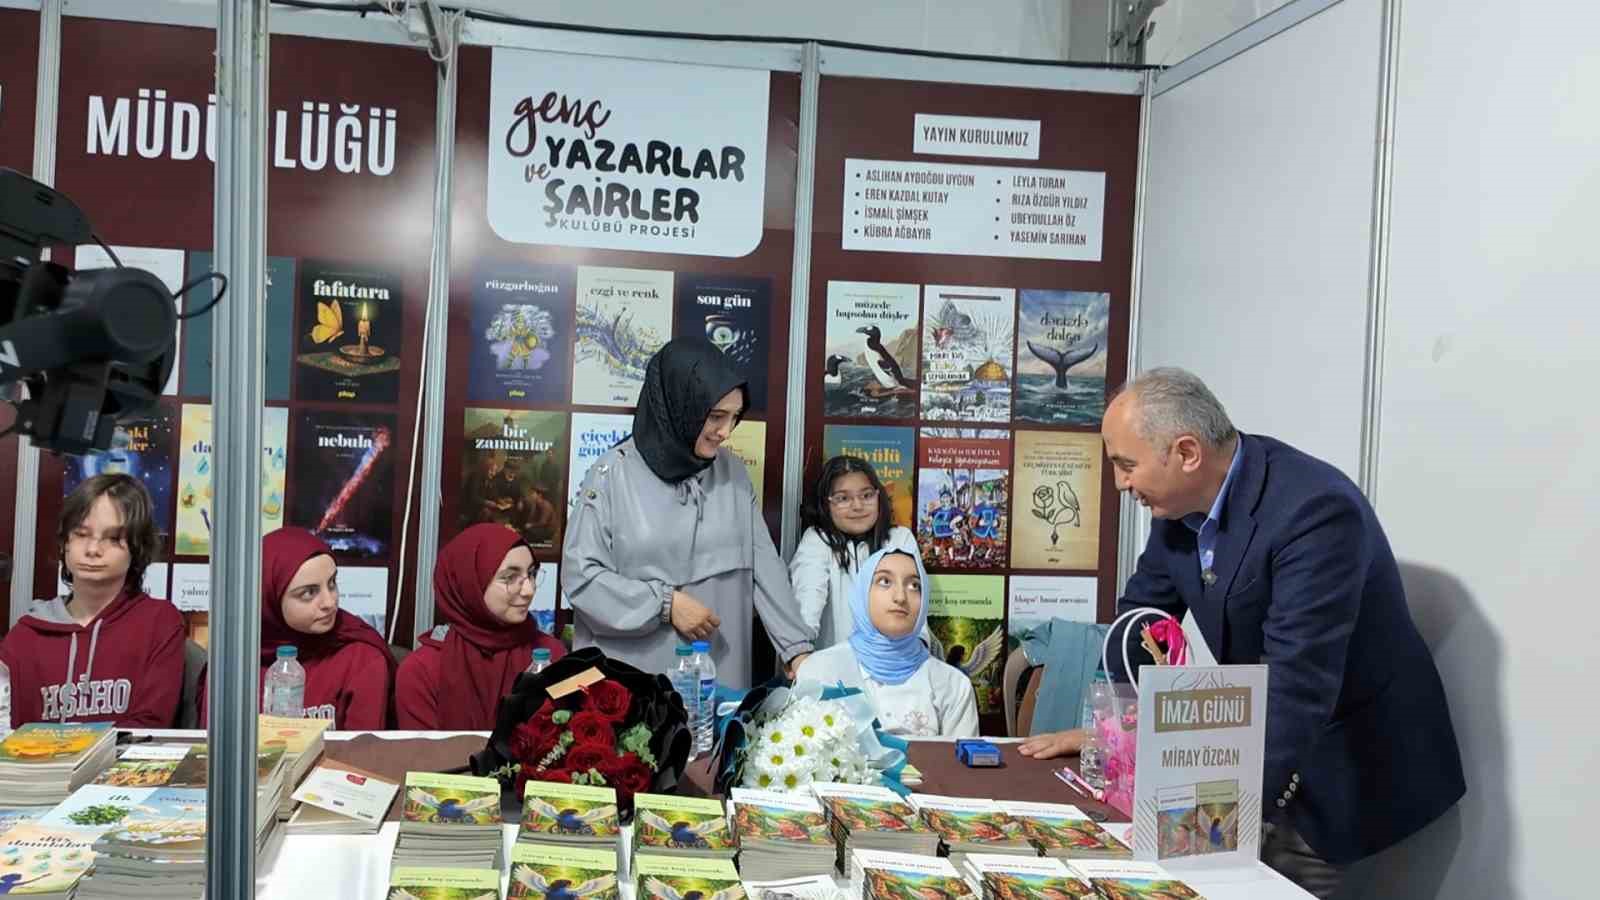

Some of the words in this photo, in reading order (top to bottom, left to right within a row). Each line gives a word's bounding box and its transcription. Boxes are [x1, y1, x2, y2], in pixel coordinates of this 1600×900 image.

[86, 88, 397, 176] MÜDLÜĞÜ
[506, 91, 611, 157] genç
[923, 126, 956, 143] YAYIN
[959, 128, 1029, 146] KURULUMUZ
[545, 135, 746, 182] YAZARLAR
[524, 163, 551, 183] ve
[866, 169, 902, 183] ASLIHAN
[1012, 175, 1036, 188] LEYLA
[1038, 176, 1066, 189] TURAN
[543, 176, 700, 228] ŞAİRLER
[865, 188, 887, 201] EREN
[922, 191, 949, 204] KUTAY
[1011, 193, 1031, 207] RIZA
[1033, 192, 1061, 208] ÖZGÜR
[1062, 196, 1088, 209] YILDIZ
[864, 204, 894, 219] İSMAİL
[896, 207, 929, 224] ŞİMŞEK
[1065, 213, 1076, 227] ÖZ
[559, 219, 623, 234] KULÜBÜ
[629, 224, 696, 239] PROJESİ
[864, 223, 893, 238] KÜBRA
[894, 225, 932, 240] AĞBAYIR
[1010, 229, 1048, 243] YASEMİN
[313, 279, 390, 301] fafatara
[485, 279, 559, 294] rüzgarboğan
[589, 286, 613, 299] ezgi
[617, 289, 630, 298] ve
[632, 287, 660, 299] renk
[697, 295, 721, 307] son
[723, 295, 751, 309] gün
[503, 423, 528, 438] bir
[317, 433, 374, 449] nebula
[474, 437, 553, 452] zamanlar
[1161, 696, 1200, 724] İMZA
[1202, 695, 1246, 724] GÜNÜ
[1161, 745, 1201, 768] MİRAY
[1202, 745, 1240, 766] ÖZCAN
